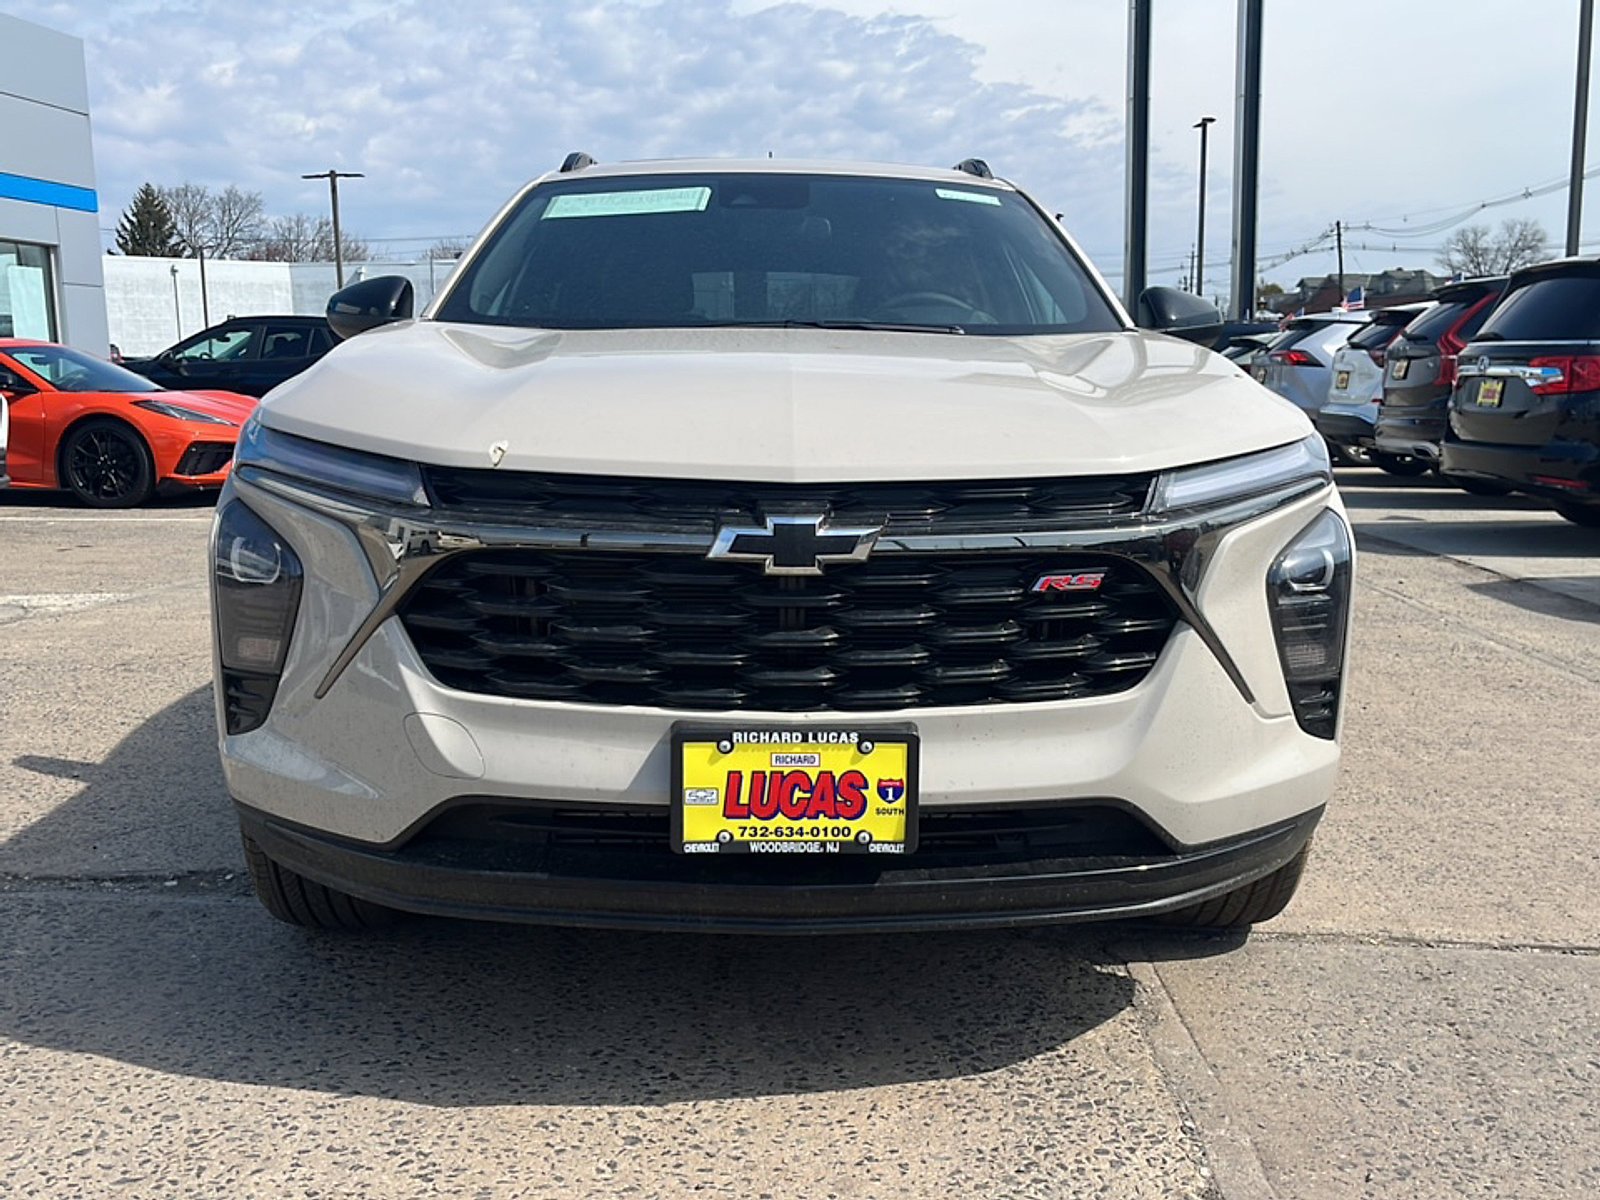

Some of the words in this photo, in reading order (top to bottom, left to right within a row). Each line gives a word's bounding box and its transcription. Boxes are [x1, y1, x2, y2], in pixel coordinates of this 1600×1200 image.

[1032, 573, 1105, 591] RS
[732, 731, 802, 743] RICHARD
[808, 731, 859, 743] LUCAS
[774, 755, 816, 765] RICHARD
[723, 770, 869, 820] LUCAS
[885, 787, 895, 800] 1
[876, 808, 905, 816] SOUTH
[738, 826, 852, 838] 732-634-0100
[826, 841, 840, 853] NJ
